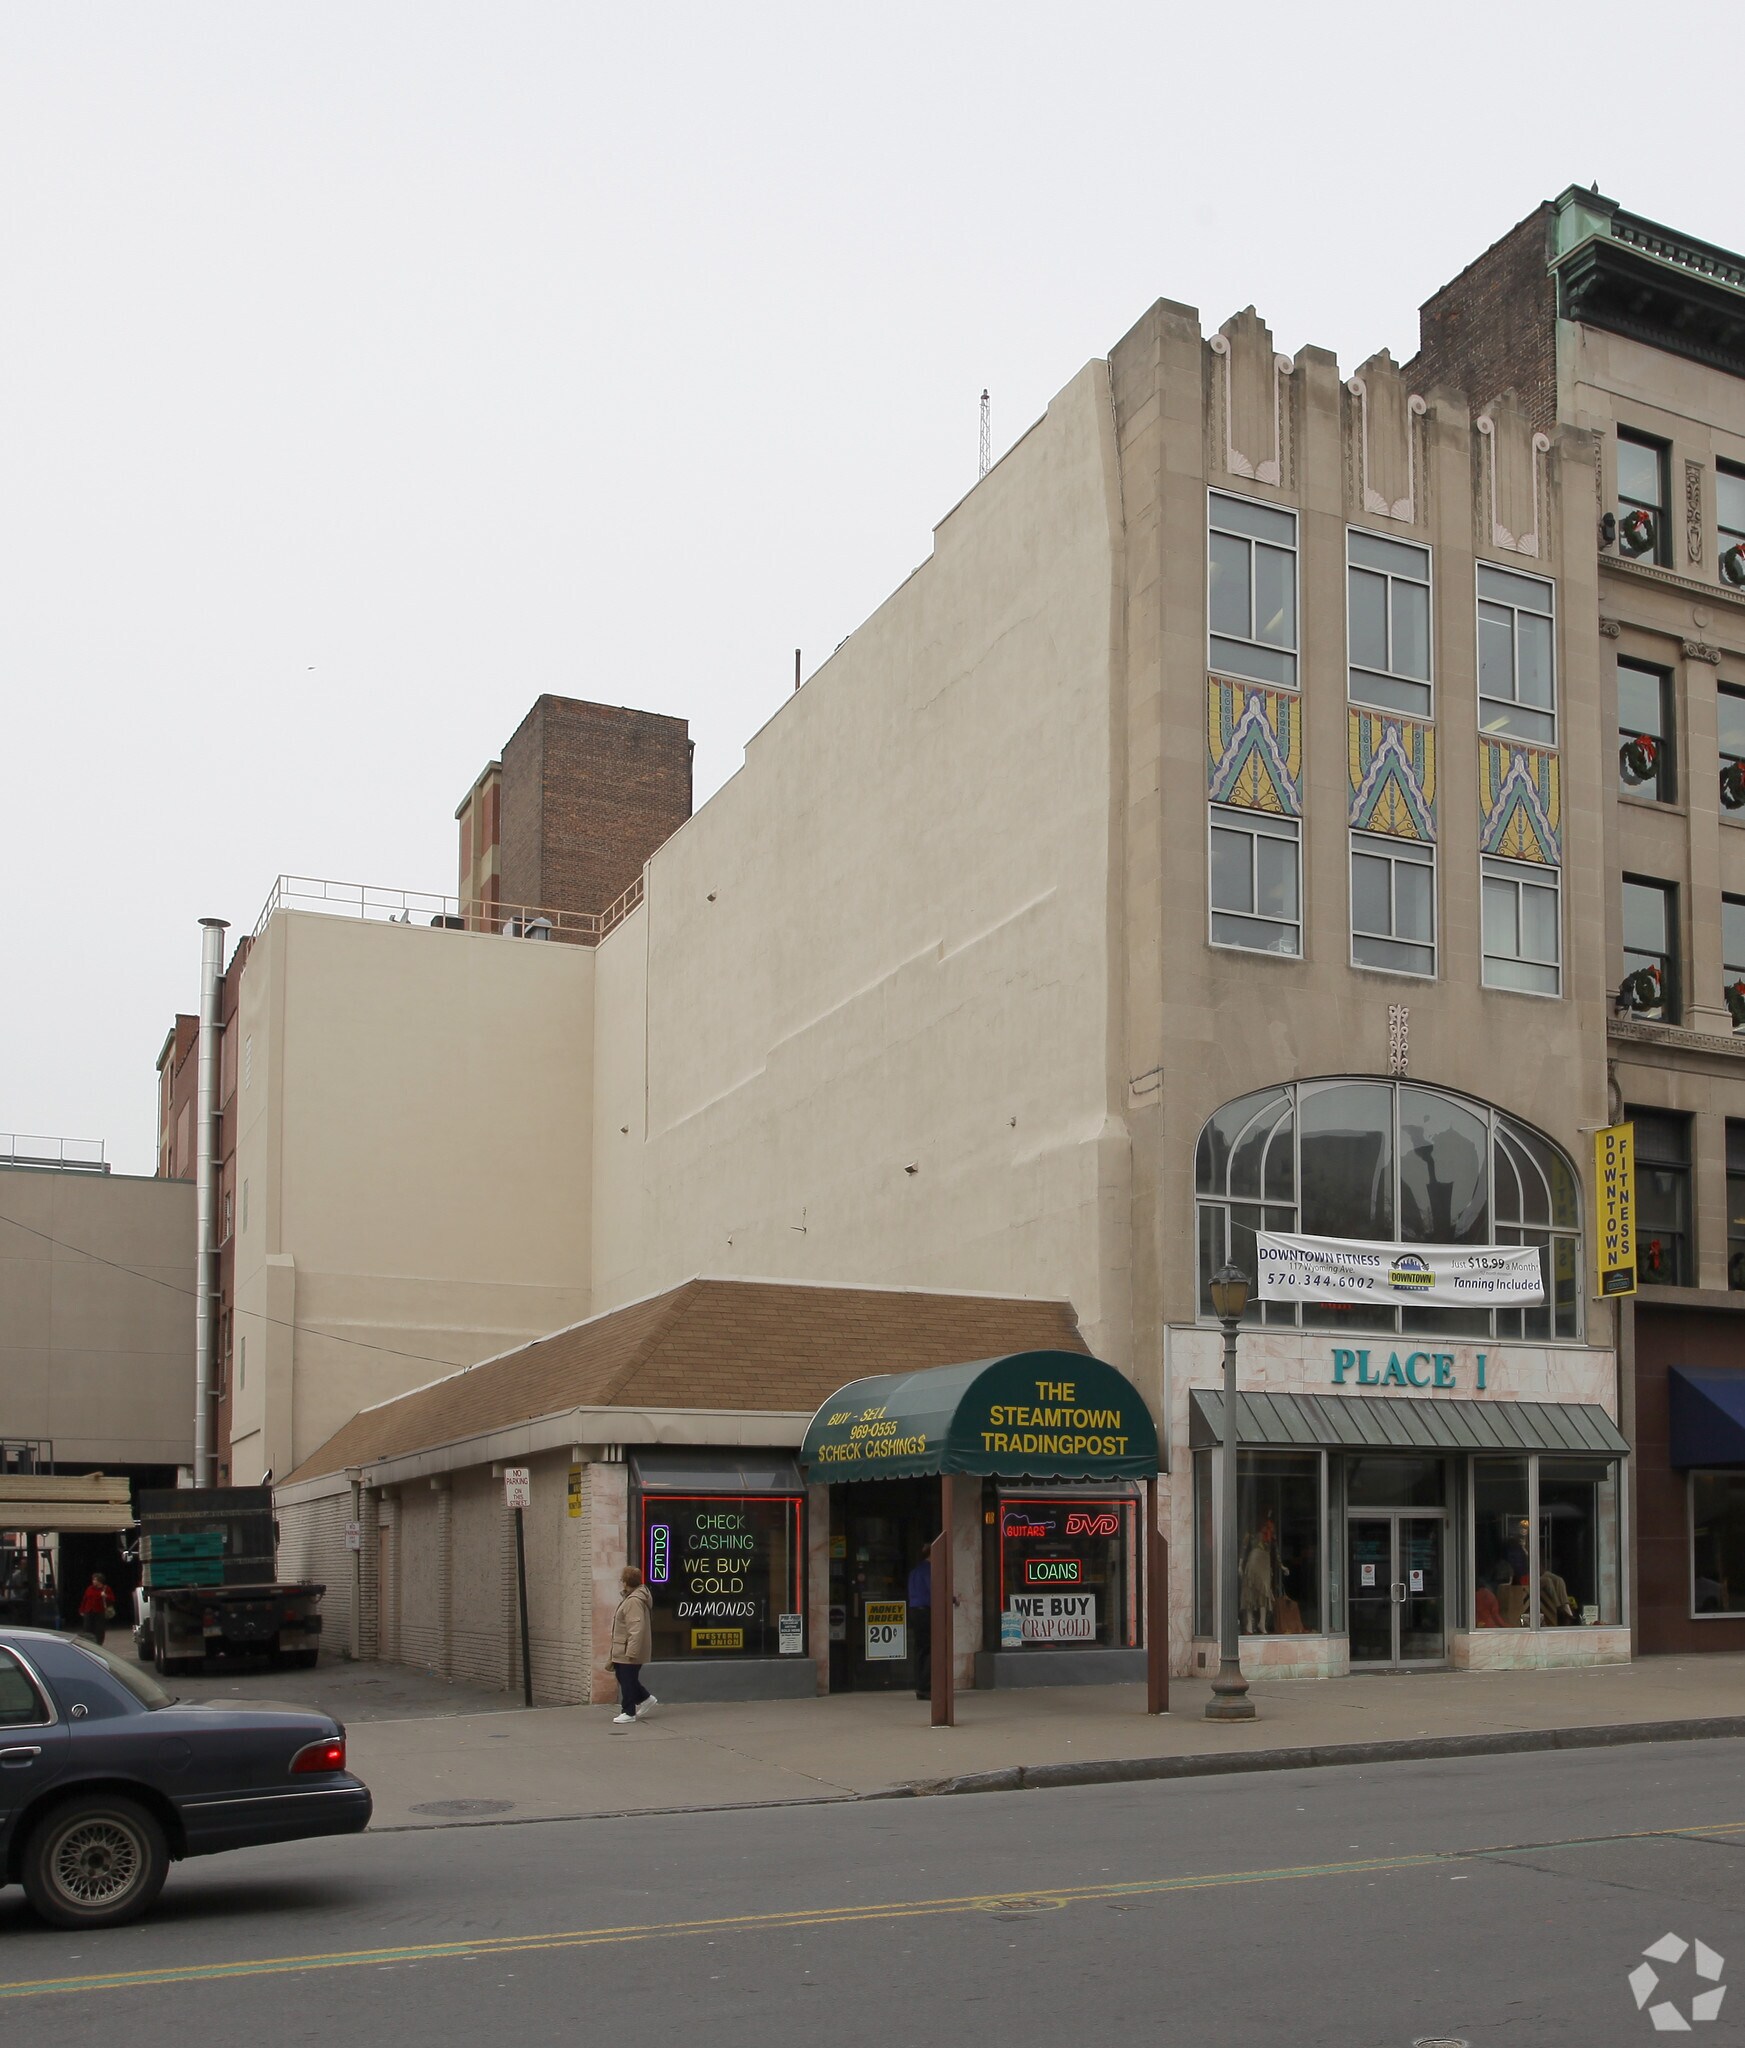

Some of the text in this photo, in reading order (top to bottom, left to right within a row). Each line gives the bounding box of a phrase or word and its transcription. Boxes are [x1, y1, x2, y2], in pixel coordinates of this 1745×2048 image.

[1604, 1134, 1618, 1266] DOWNTOWN
[1618, 1139, 1630, 1255] FITNESS
[1259, 1248, 1381, 1266] DOWNTOWN FITNESS
[1451, 1259, 1467, 1269] Just
[1468, 1256, 1505, 1269] $18.99
[1289, 1262, 1355, 1274] 117 Wyoming Ave.
[1267, 1273, 1374, 1289] 570.344.6002
[1391, 1272, 1432, 1283] DOWNTOWN
[1454, 1276, 1540, 1292] Tanning Included
[1331, 1348, 1487, 1389] PLACE I
[1035, 1381, 1076, 1402] THE
[827, 1412, 852, 1426] BUY
[859, 1406, 887, 1422] SELL
[989, 1405, 1121, 1429] STEAMTOWN
[849, 1421, 898, 1440] 969-0555
[980, 1432, 1129, 1456] TRADINGPOST
[506, 1477, 528, 1485] PARKING
[512, 1469, 522, 1477] NO
[696, 1514, 746, 1530] CHECK
[1065, 1513, 1119, 1536] DVD
[1006, 1525, 1046, 1537] GUITARS
[688, 1534, 754, 1550] CASHING
[653, 1527, 667, 1579] OPEN
[683, 1558, 751, 1573] WE BUY
[1028, 1562, 1078, 1580] LOANS
[690, 1578, 744, 1594] GOLD
[678, 1601, 756, 1617] DIAMONDS
[870, 1605, 904, 1614] MONEY
[1014, 1597, 1090, 1617] WE BUY
[868, 1614, 904, 1623] ORDERS
[1057, 1618, 1091, 1637] GOLD
[697, 1632, 740, 1640] WESTERN
